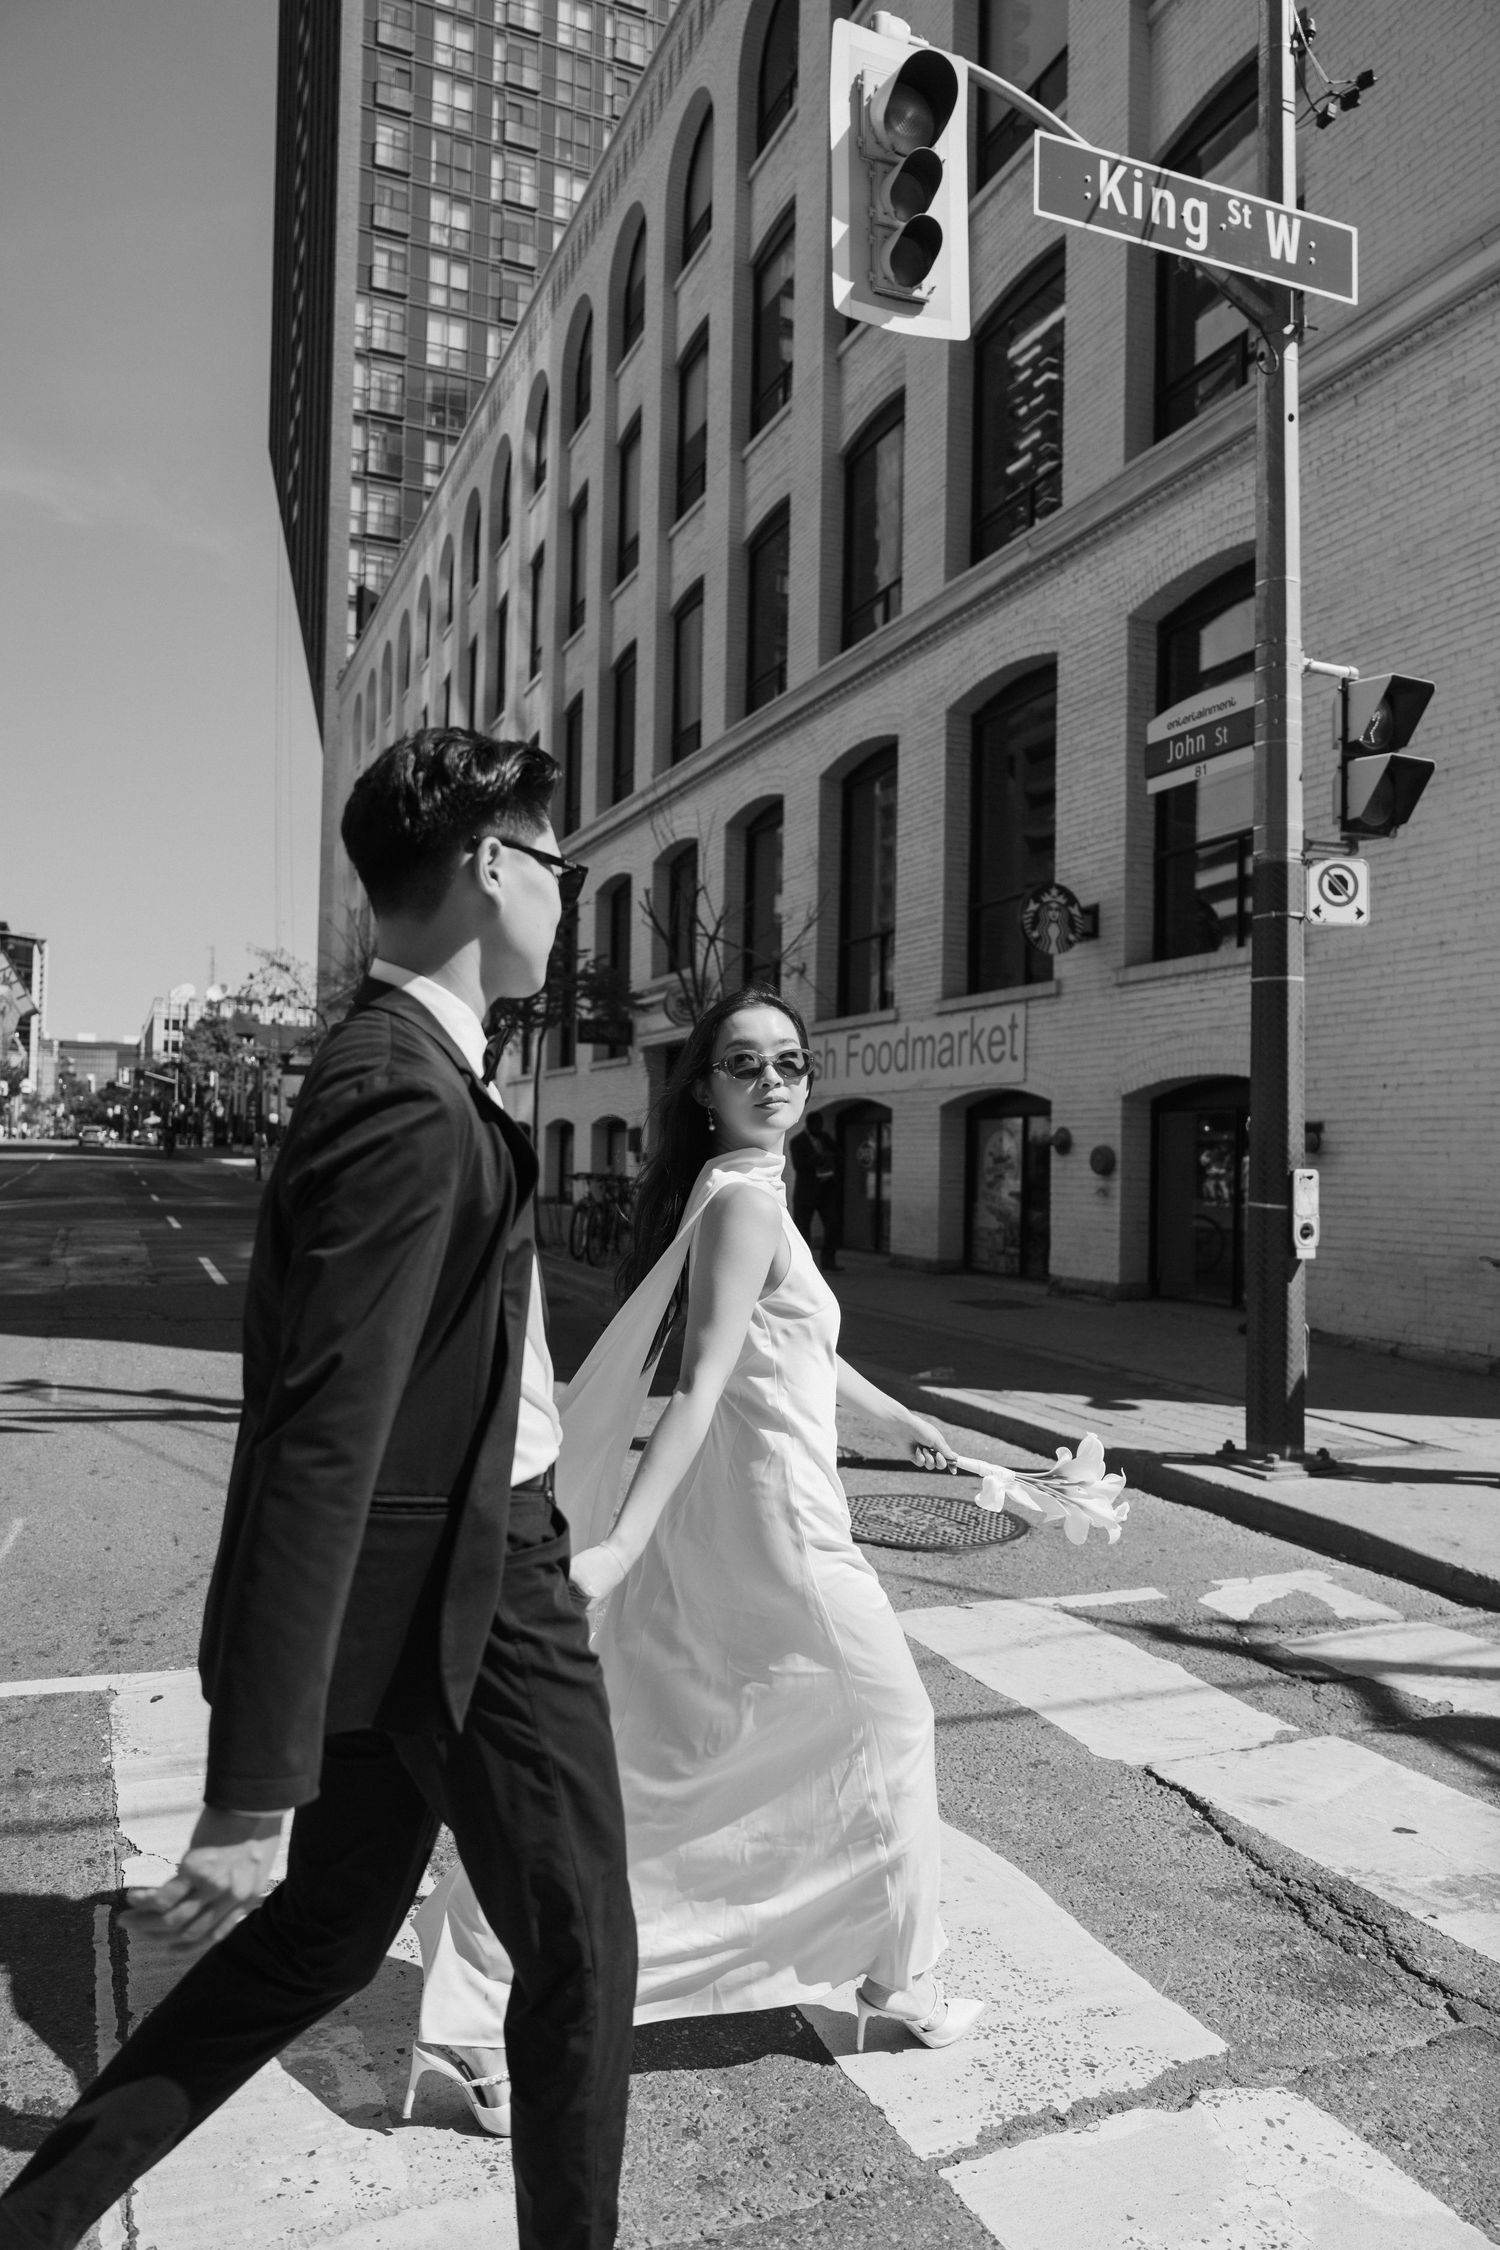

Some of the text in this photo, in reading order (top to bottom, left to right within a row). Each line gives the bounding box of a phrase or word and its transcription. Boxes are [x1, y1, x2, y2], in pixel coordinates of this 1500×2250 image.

[1099, 159, 1301, 264] King St W
[1166, 697, 1237, 730] entertainment
[1167, 726, 1228, 763] John St
[1194, 764, 1207, 778] 81
[845, 1012, 1020, 1077] Foodmarket
